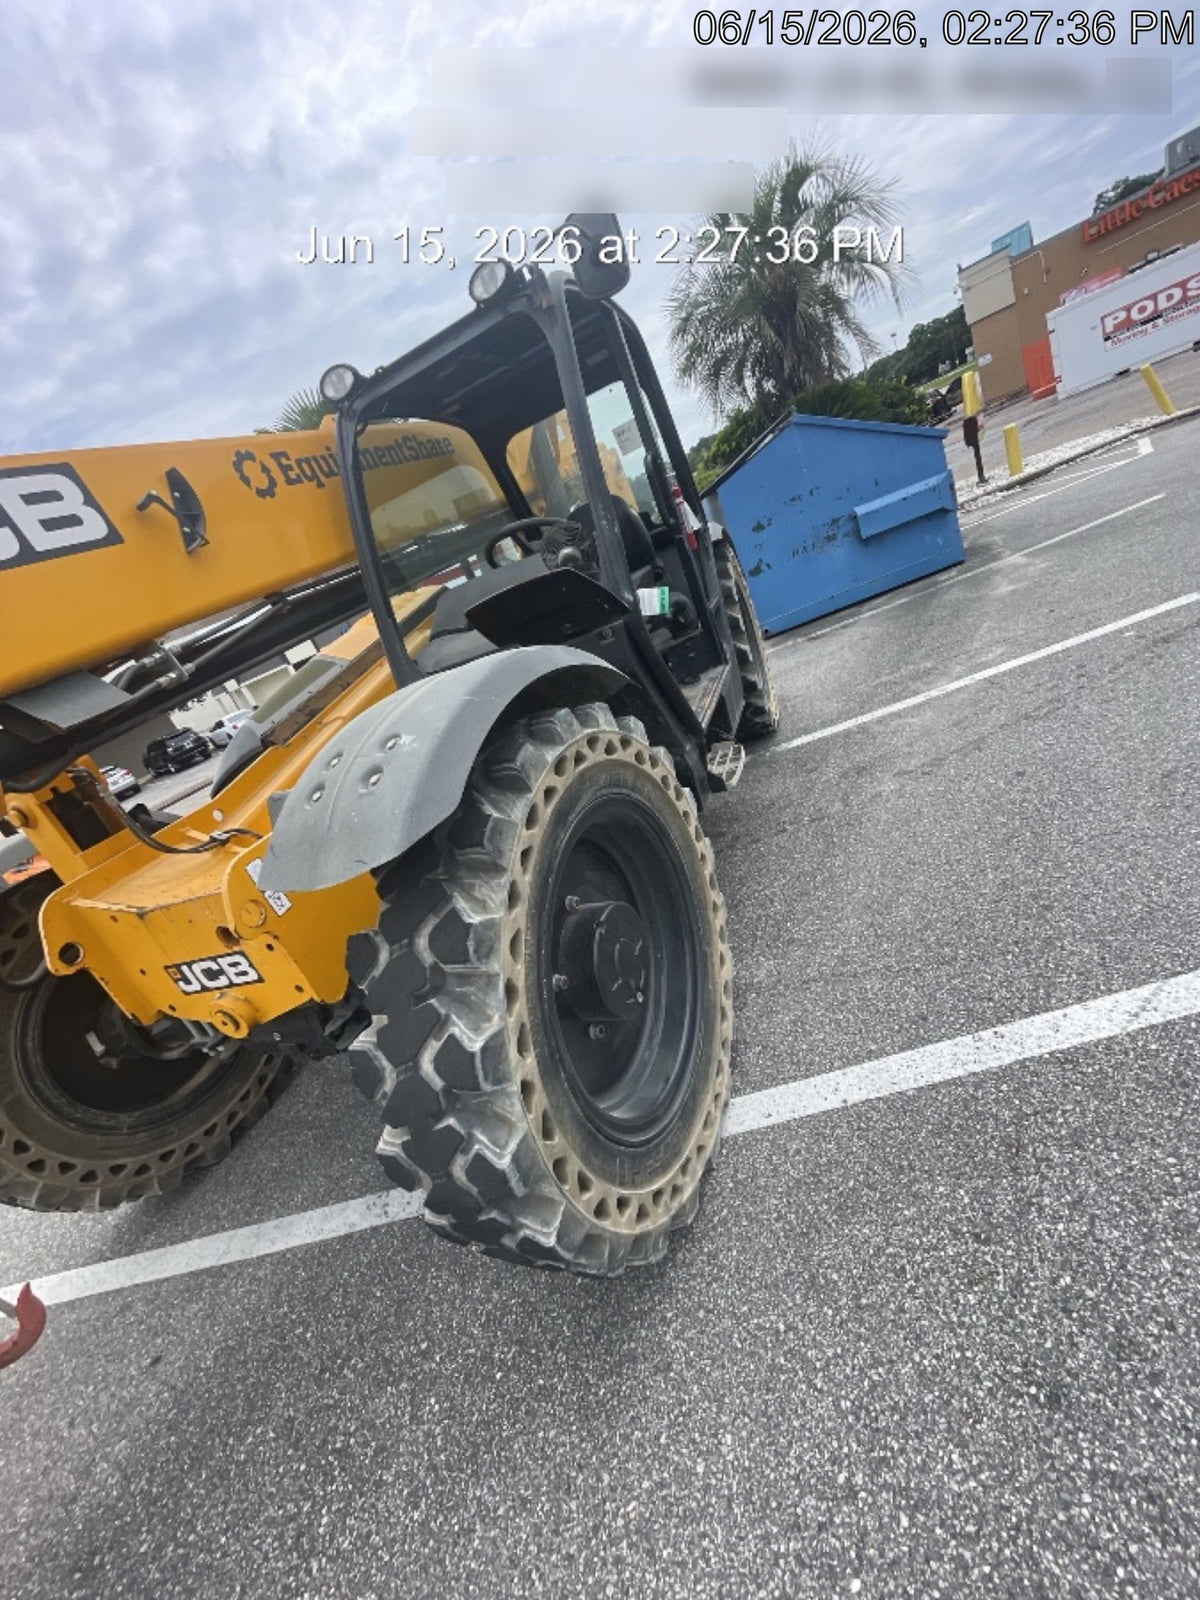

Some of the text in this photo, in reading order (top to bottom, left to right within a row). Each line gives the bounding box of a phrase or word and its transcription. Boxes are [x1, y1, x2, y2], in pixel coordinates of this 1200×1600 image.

[1082, 200, 1143, 244] Little
[269, 433, 456, 489] EquimentShare
[177, 952, 259, 993] JCB
